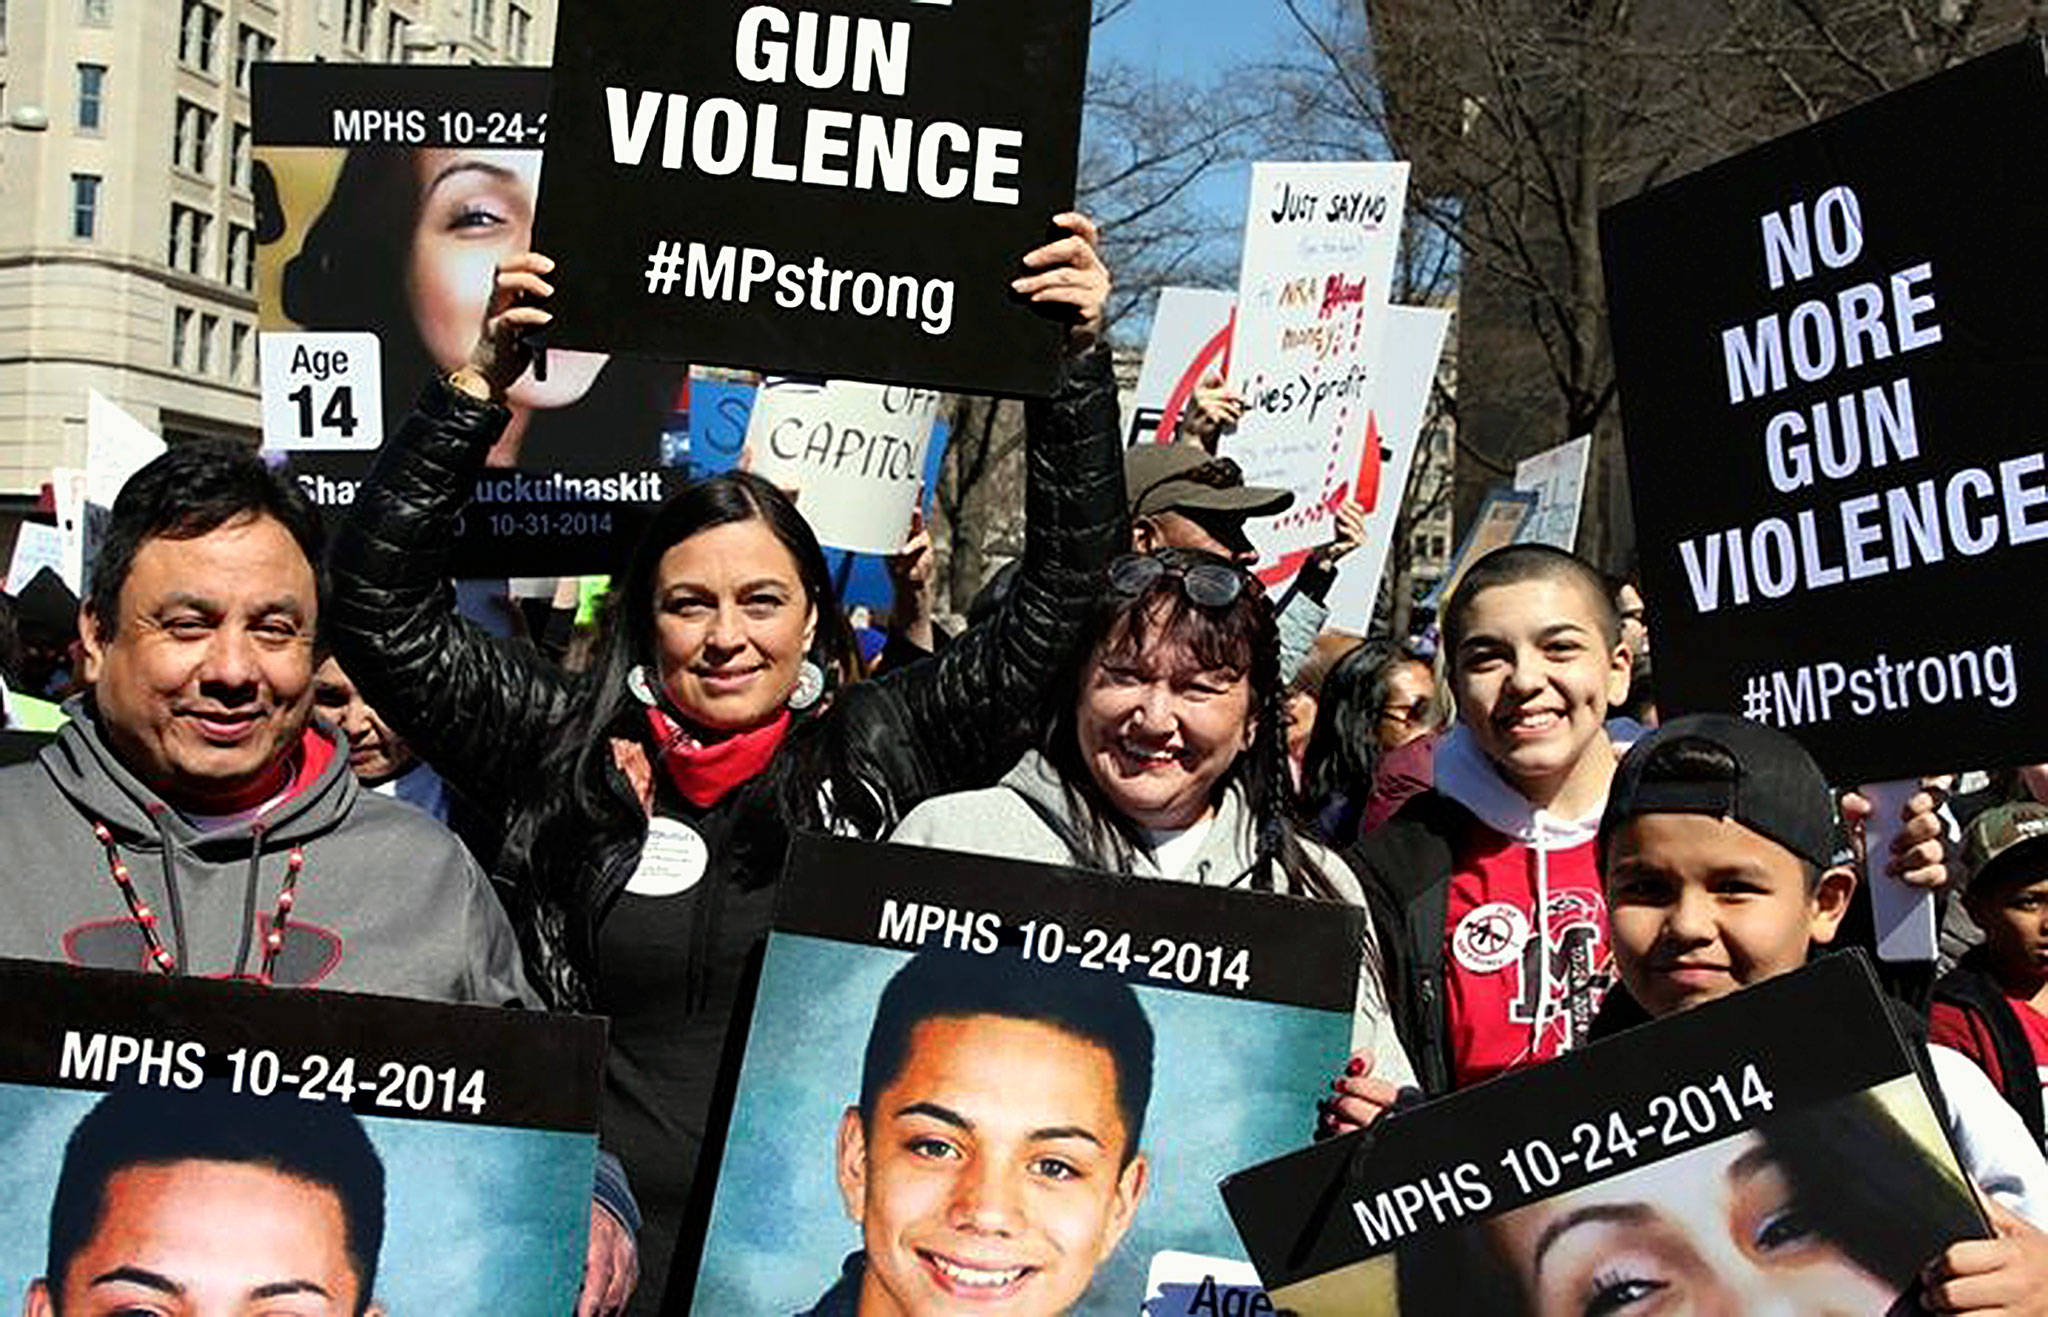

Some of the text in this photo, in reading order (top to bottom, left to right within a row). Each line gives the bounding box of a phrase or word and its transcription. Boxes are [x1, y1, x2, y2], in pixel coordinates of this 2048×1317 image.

[736, 5, 911, 96] GUN
[333, 109, 426, 142] MPHS
[605, 86, 1023, 205] VIOLENCE
[1761, 185, 1864, 291] NO
[645, 240, 955, 335] #MPstrong
[291, 344, 349, 380] Age
[1721, 262, 1943, 405] MORE
[288, 385, 358, 438] 14
[770, 417, 920, 482] CAPITOL
[1764, 377, 1920, 493] GUN
[299, 473, 663, 505] Sha uckulnaskit
[489, 512, 613, 536] 10-31-2014
[1678, 452, 2048, 614] VIOLENCE
[1743, 643, 2018, 728] #MPstrong
[878, 899, 1250, 990] MPHS 10-24-2014
[60, 1030, 487, 1114] MPHS 10-24-2014
[1352, 1064, 1774, 1246] MPHS 10-24-2014
